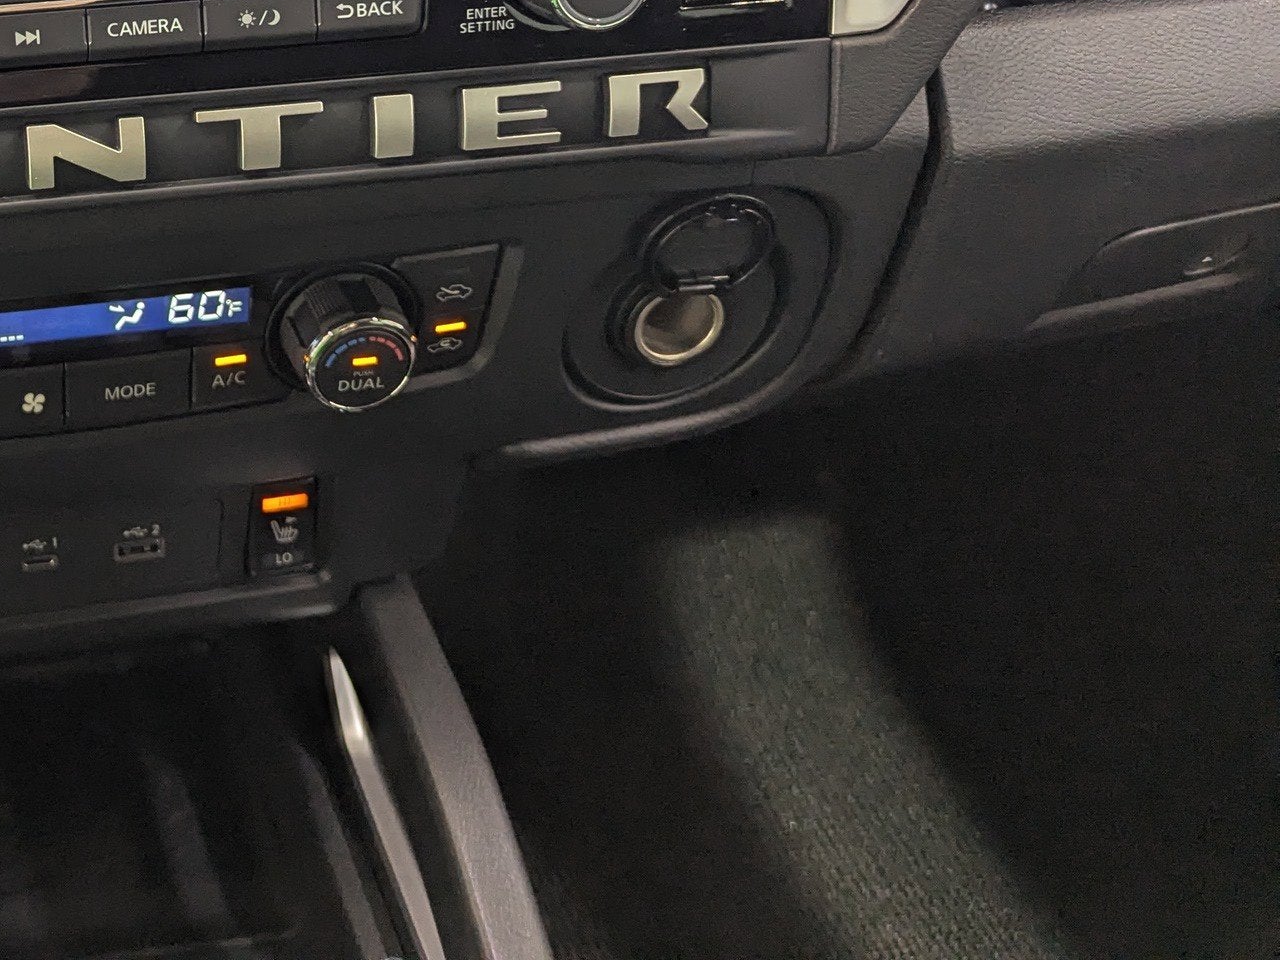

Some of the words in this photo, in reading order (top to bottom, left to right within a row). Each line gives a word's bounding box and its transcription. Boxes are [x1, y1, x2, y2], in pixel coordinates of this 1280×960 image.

[356, 0, 403, 18] BACK
[466, 6, 507, 21] ENTER
[107, 18, 183, 37] CAMERA
[459, 18, 515, 34] SETTING
[212, 371, 246, 388] A/C
[338, 376, 385, 392] DUAL
[105, 383, 156, 400] MODE
